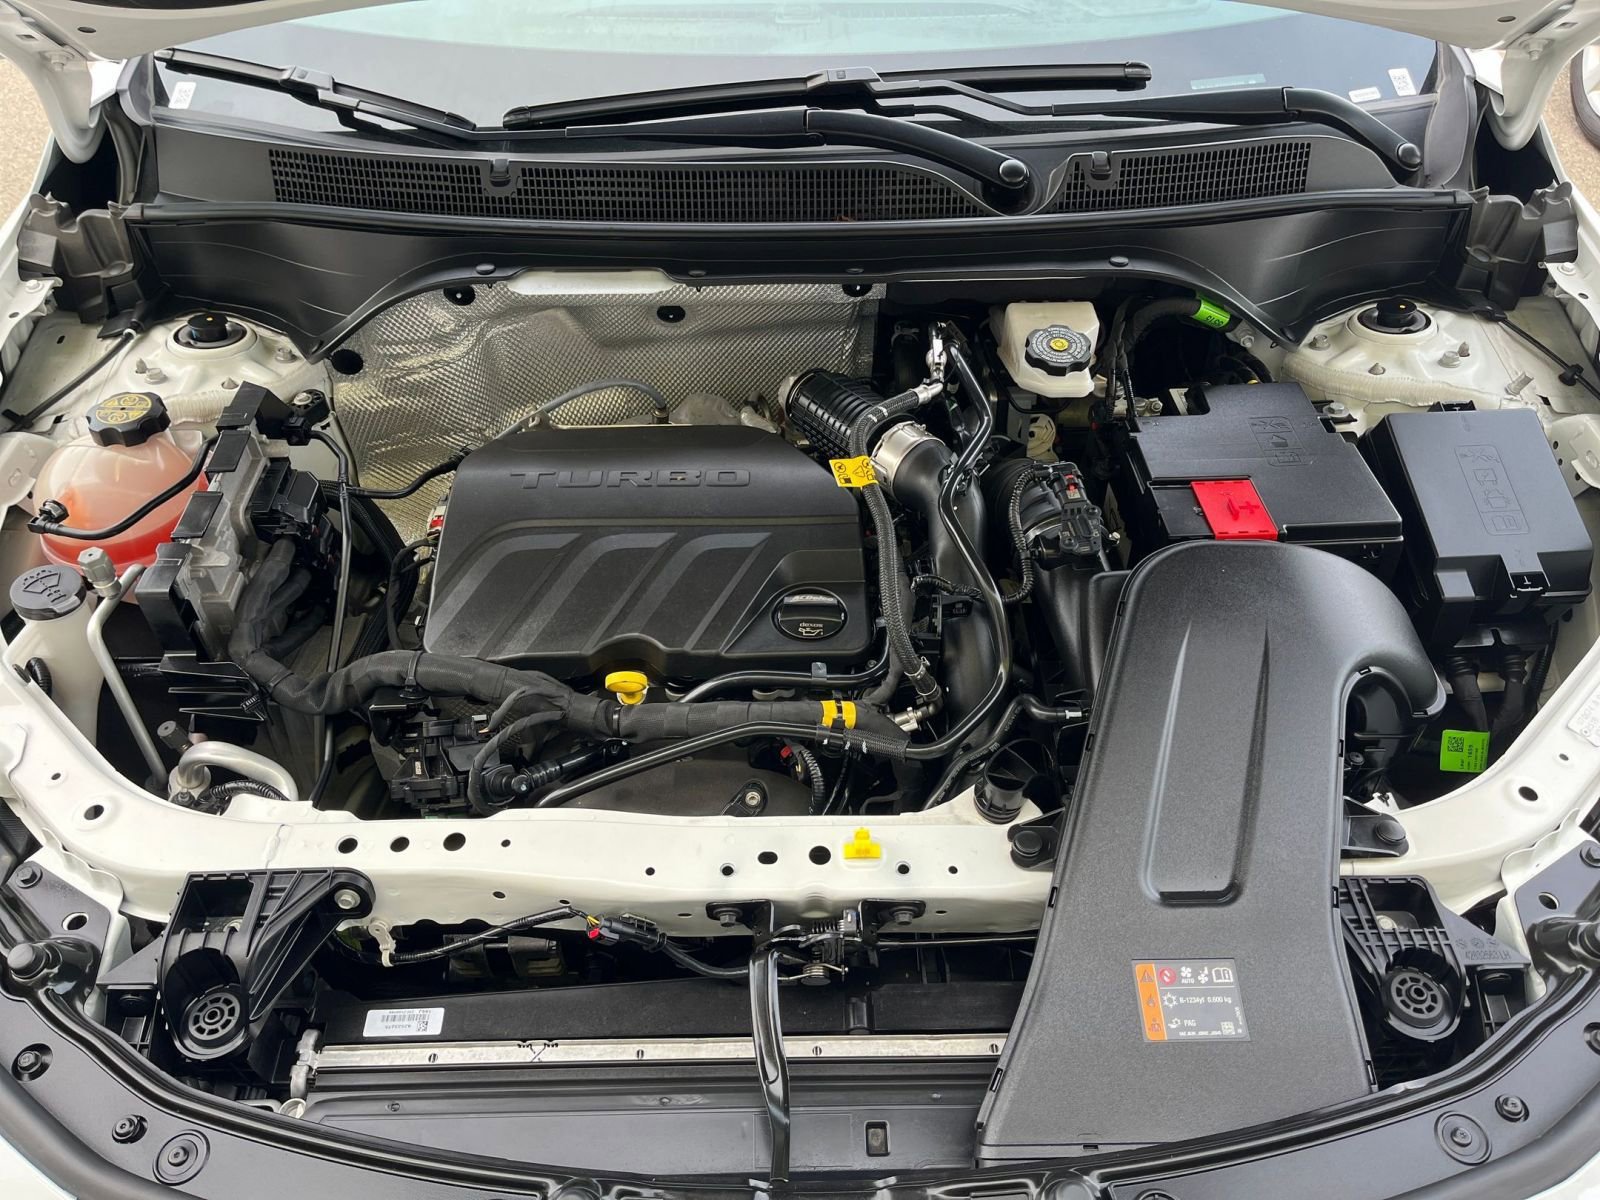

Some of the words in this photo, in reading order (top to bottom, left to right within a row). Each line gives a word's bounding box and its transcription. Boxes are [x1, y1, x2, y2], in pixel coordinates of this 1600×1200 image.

[510, 471, 750, 489] TURBO
[1224, 995, 1232, 1005] kg
[1183, 1019, 1197, 1027] PAG
